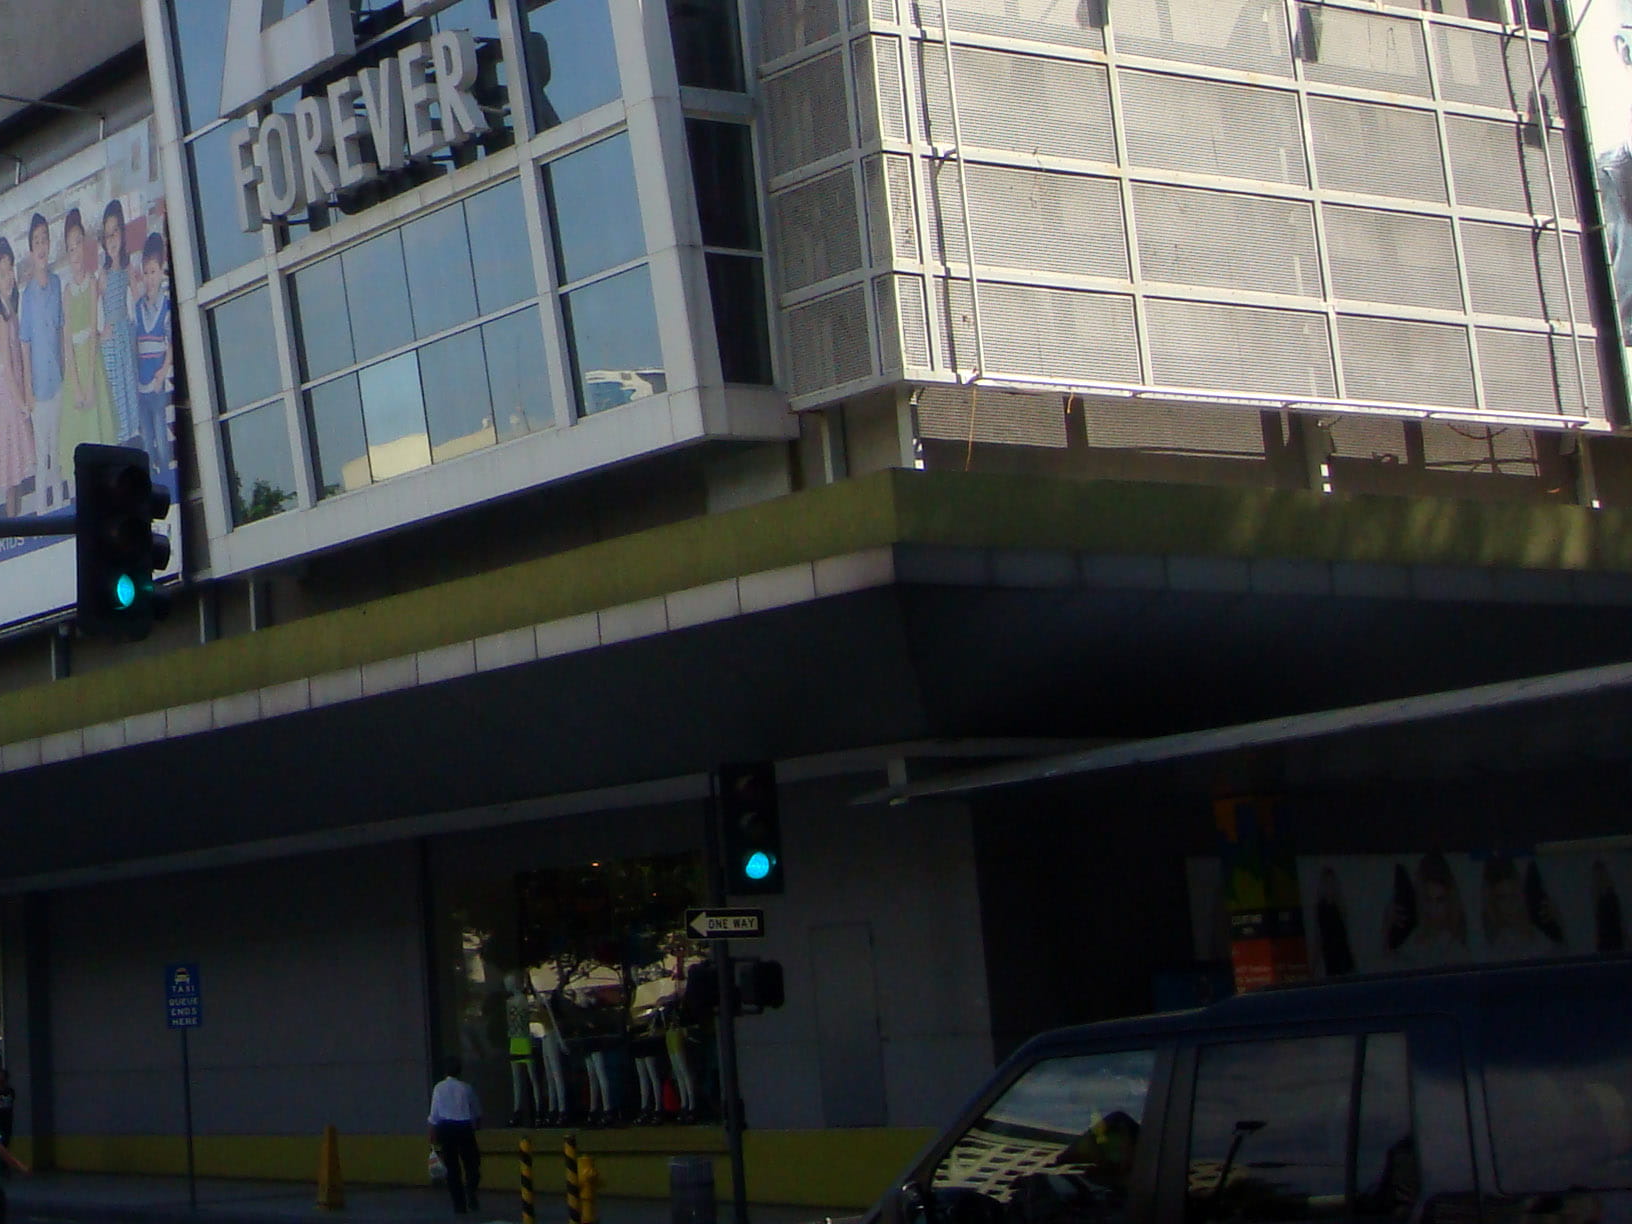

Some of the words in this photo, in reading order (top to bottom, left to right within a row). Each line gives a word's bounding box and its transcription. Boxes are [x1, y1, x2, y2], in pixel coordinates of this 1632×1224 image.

[231, 28, 490, 233] FOREVER
[0, 536, 25, 553] KIDS
[708, 918, 728, 929] ONE
[733, 918, 755, 928] WAY
